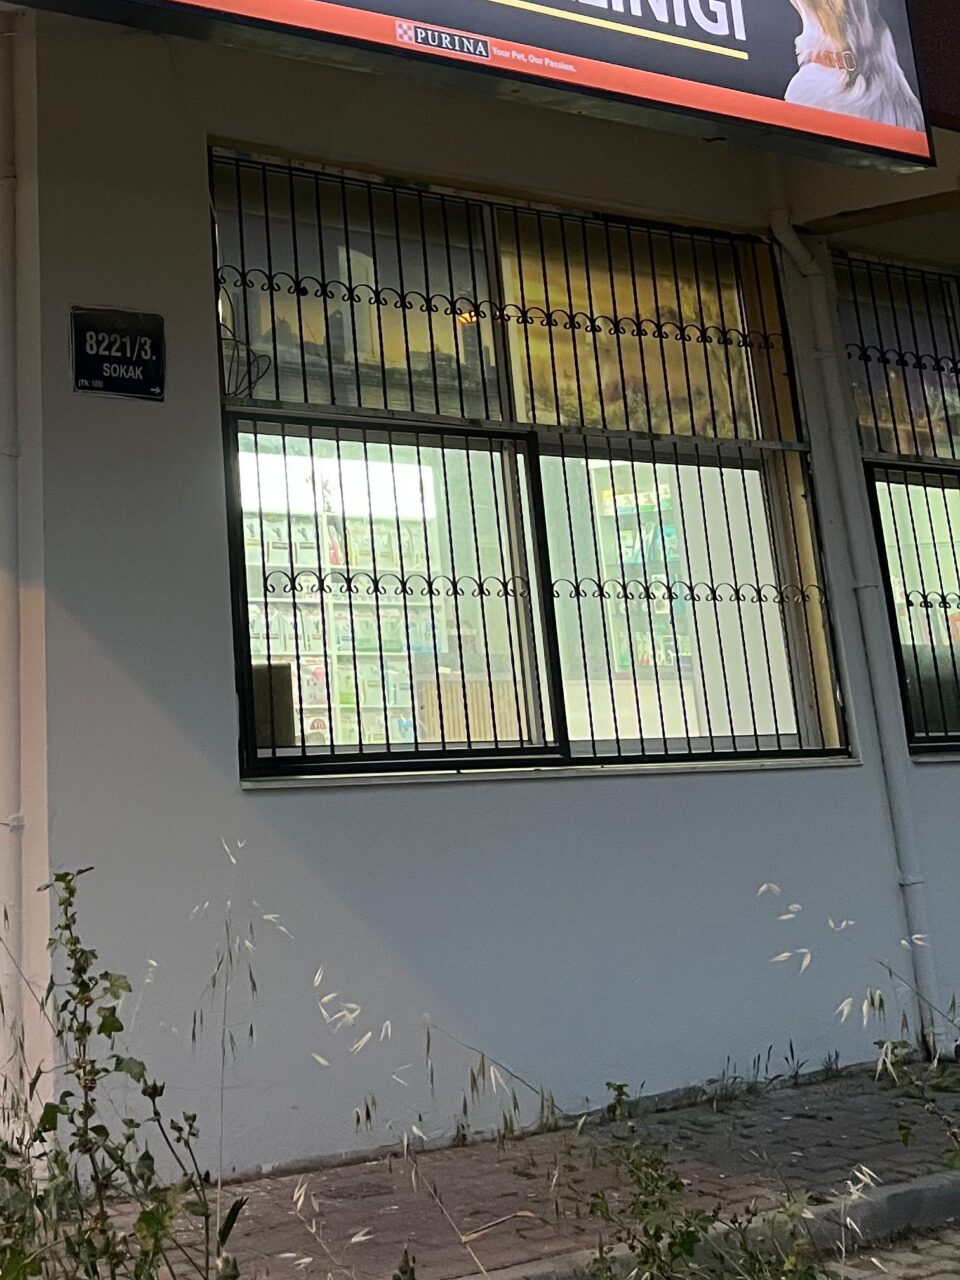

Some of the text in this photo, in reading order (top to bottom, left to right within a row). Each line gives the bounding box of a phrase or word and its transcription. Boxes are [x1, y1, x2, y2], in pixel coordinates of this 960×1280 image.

[415, 28, 488, 57] PURINA
[491, 46, 511, 59] Your
[528, 54, 544, 66] Our
[102, 362, 144, 381] SOKAK
